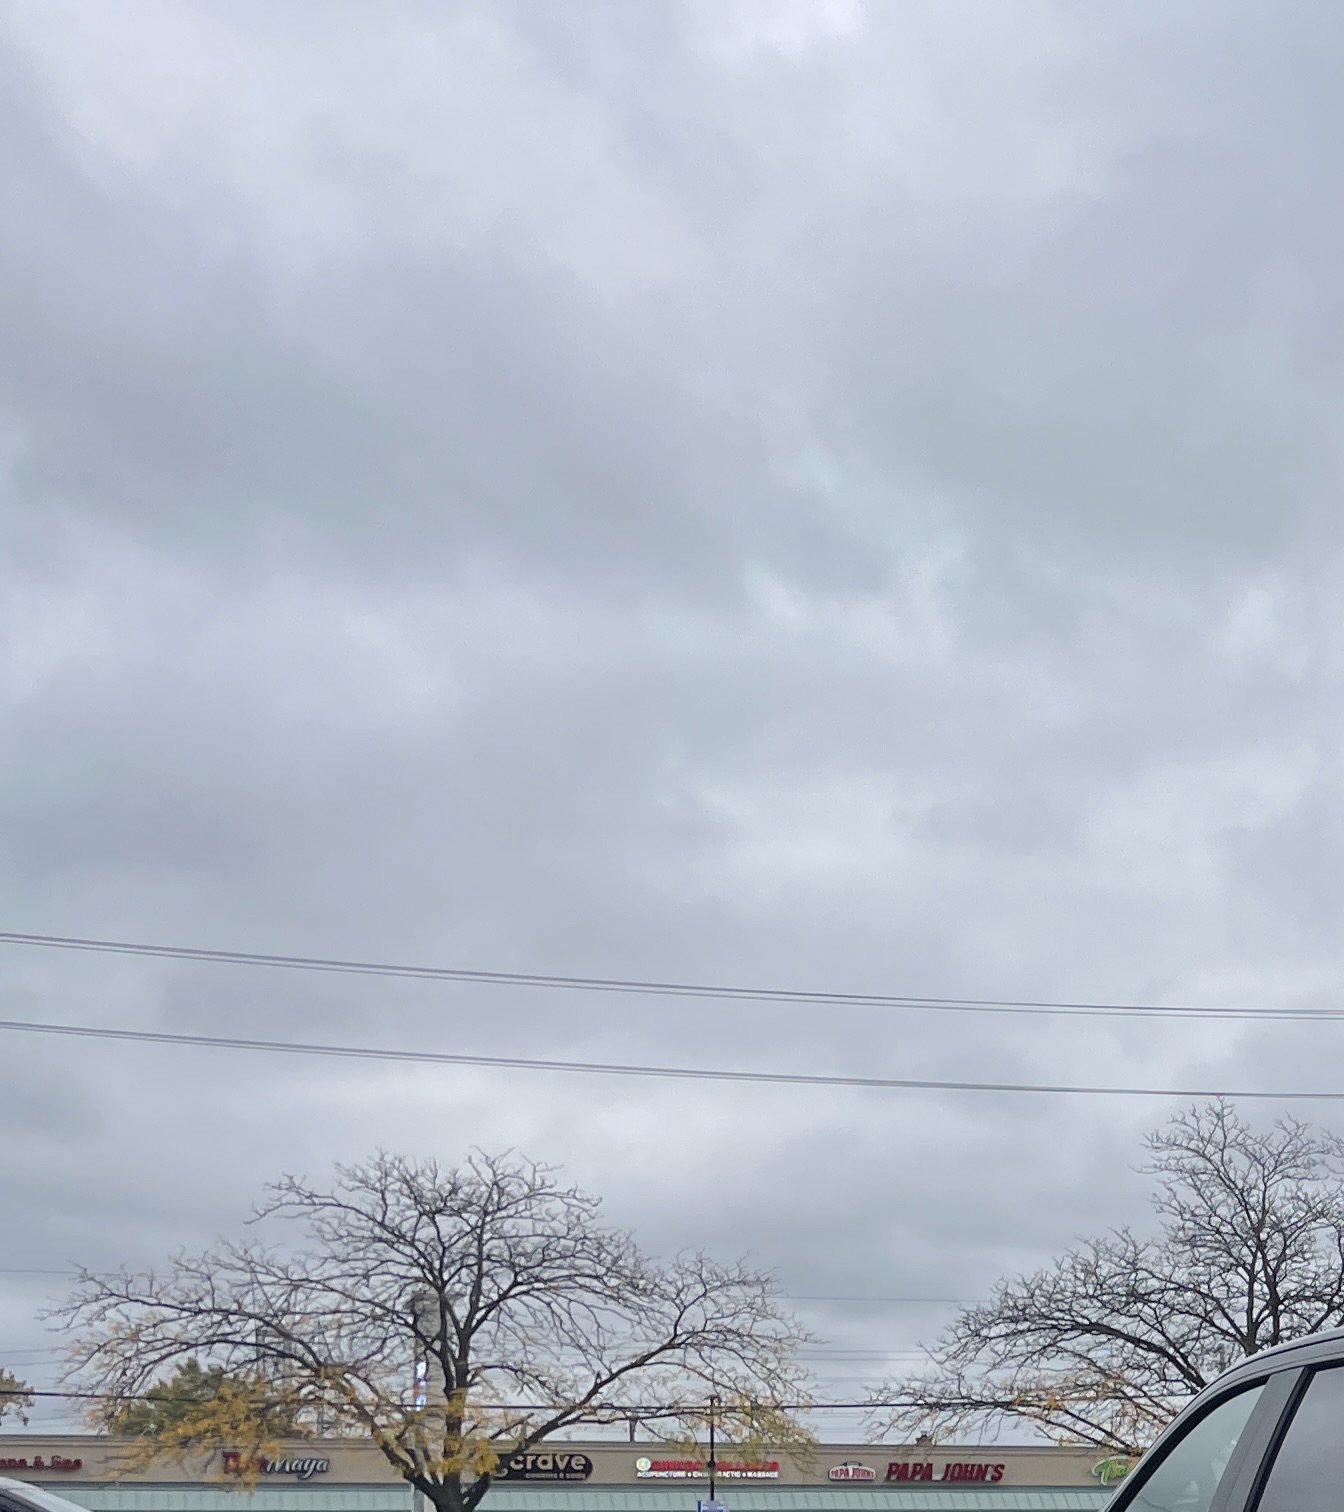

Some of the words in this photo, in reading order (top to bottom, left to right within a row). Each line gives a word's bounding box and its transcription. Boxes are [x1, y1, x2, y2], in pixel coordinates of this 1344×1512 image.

[266, 1458, 330, 1480] Maya
[510, 1453, 587, 1471] crave
[886, 1462, 934, 1481] PAPA
[941, 1463, 1006, 1482] JOHN'S
